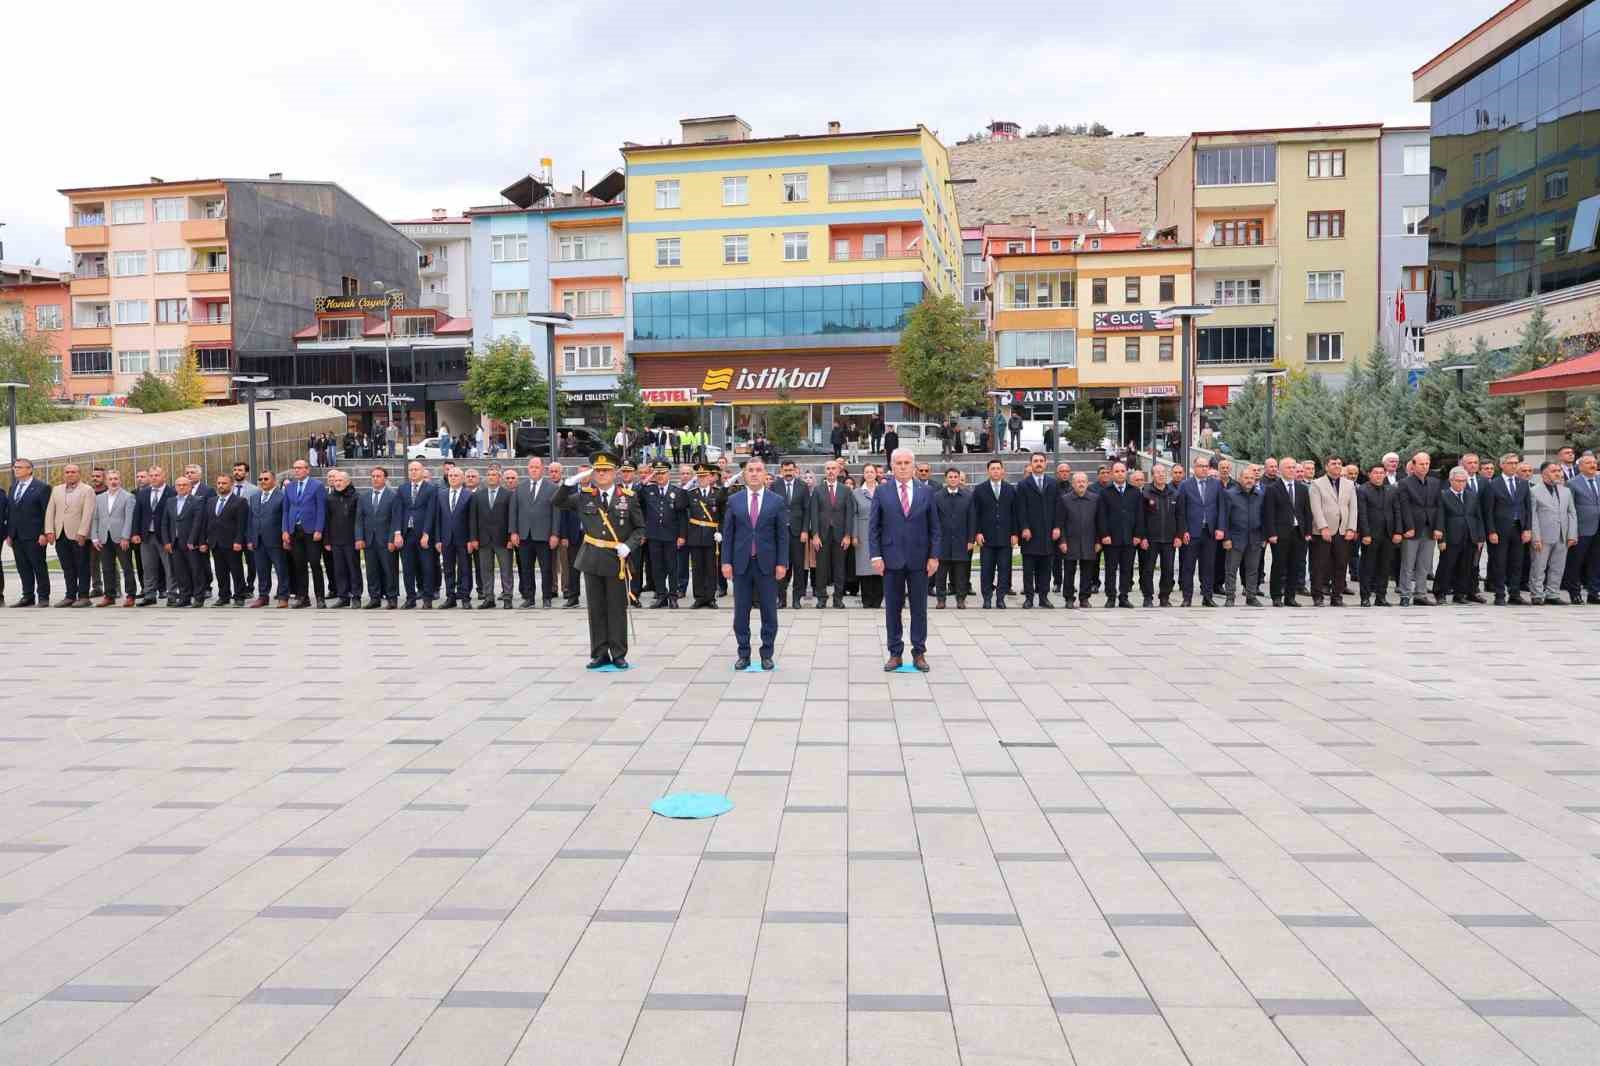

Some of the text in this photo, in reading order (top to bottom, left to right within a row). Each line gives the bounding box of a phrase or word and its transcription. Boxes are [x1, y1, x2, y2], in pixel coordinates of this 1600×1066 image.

[736, 367, 831, 390] istikbal
[311, 392, 407, 407] bambi YATA
[641, 391, 687, 401] VESTEL
